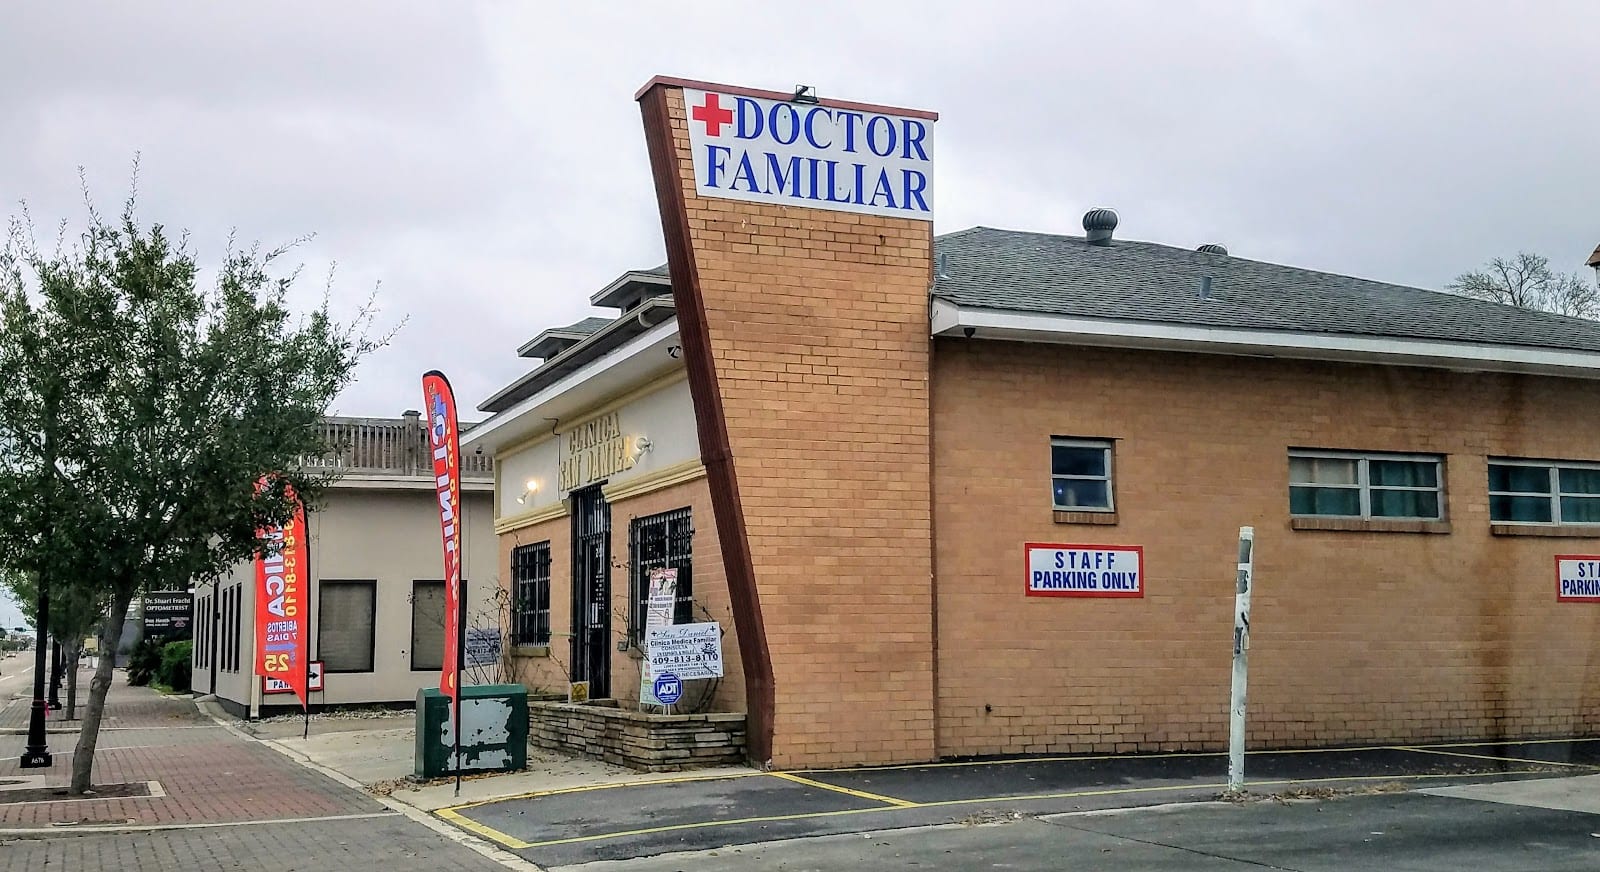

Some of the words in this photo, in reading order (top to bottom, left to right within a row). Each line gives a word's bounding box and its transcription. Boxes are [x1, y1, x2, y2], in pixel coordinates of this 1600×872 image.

[734, 97, 930, 162] DOCTOR
[704, 143, 930, 212] FAMILIAR
[569, 411, 620, 455] CLINICA
[560, 454, 582, 492] SAN
[586, 435, 632, 483] DANIEL
[1055, 551, 1115, 569] STAFF
[1033, 571, 1097, 589] PARKING
[1102, 571, 1136, 589] ONLY
[652, 654, 719, 665] 409-813-8110
[659, 682, 677, 695] ADT
